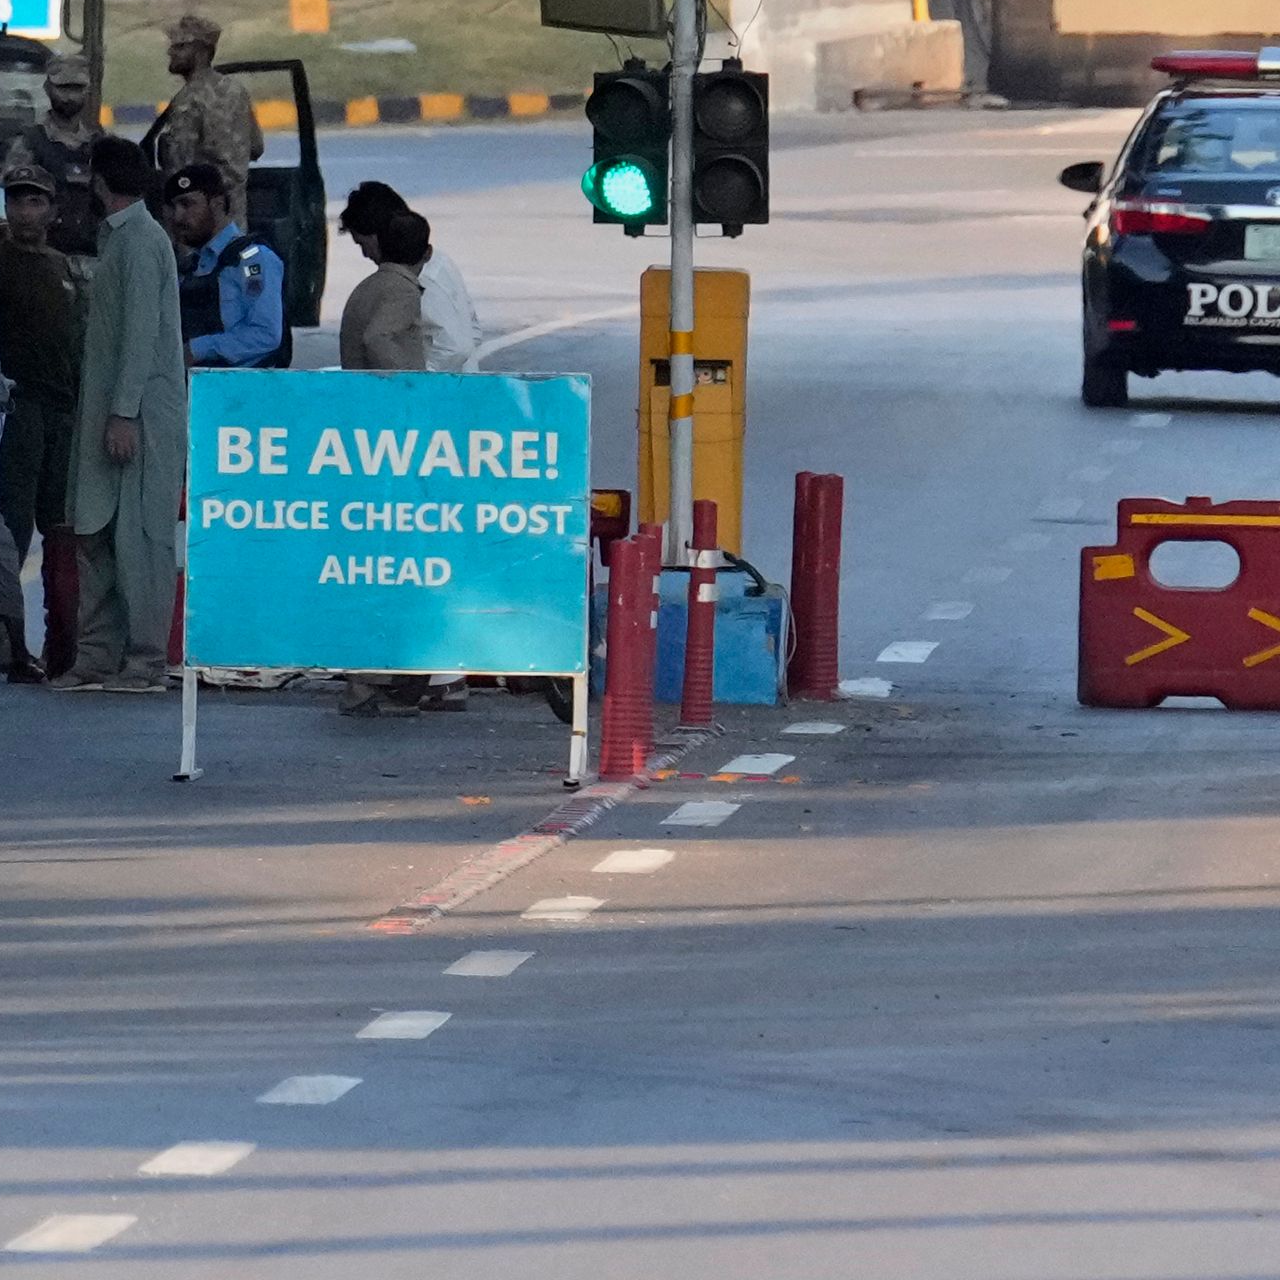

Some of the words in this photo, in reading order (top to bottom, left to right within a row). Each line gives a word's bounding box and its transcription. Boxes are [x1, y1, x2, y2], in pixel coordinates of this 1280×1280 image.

[217, 426, 289, 476] BE
[307, 428, 560, 480] AWARE!
[202, 499, 330, 531] POLICE
[340, 501, 464, 533] CHECK
[476, 504, 573, 535] POST
[318, 555, 452, 587] AHEAD
